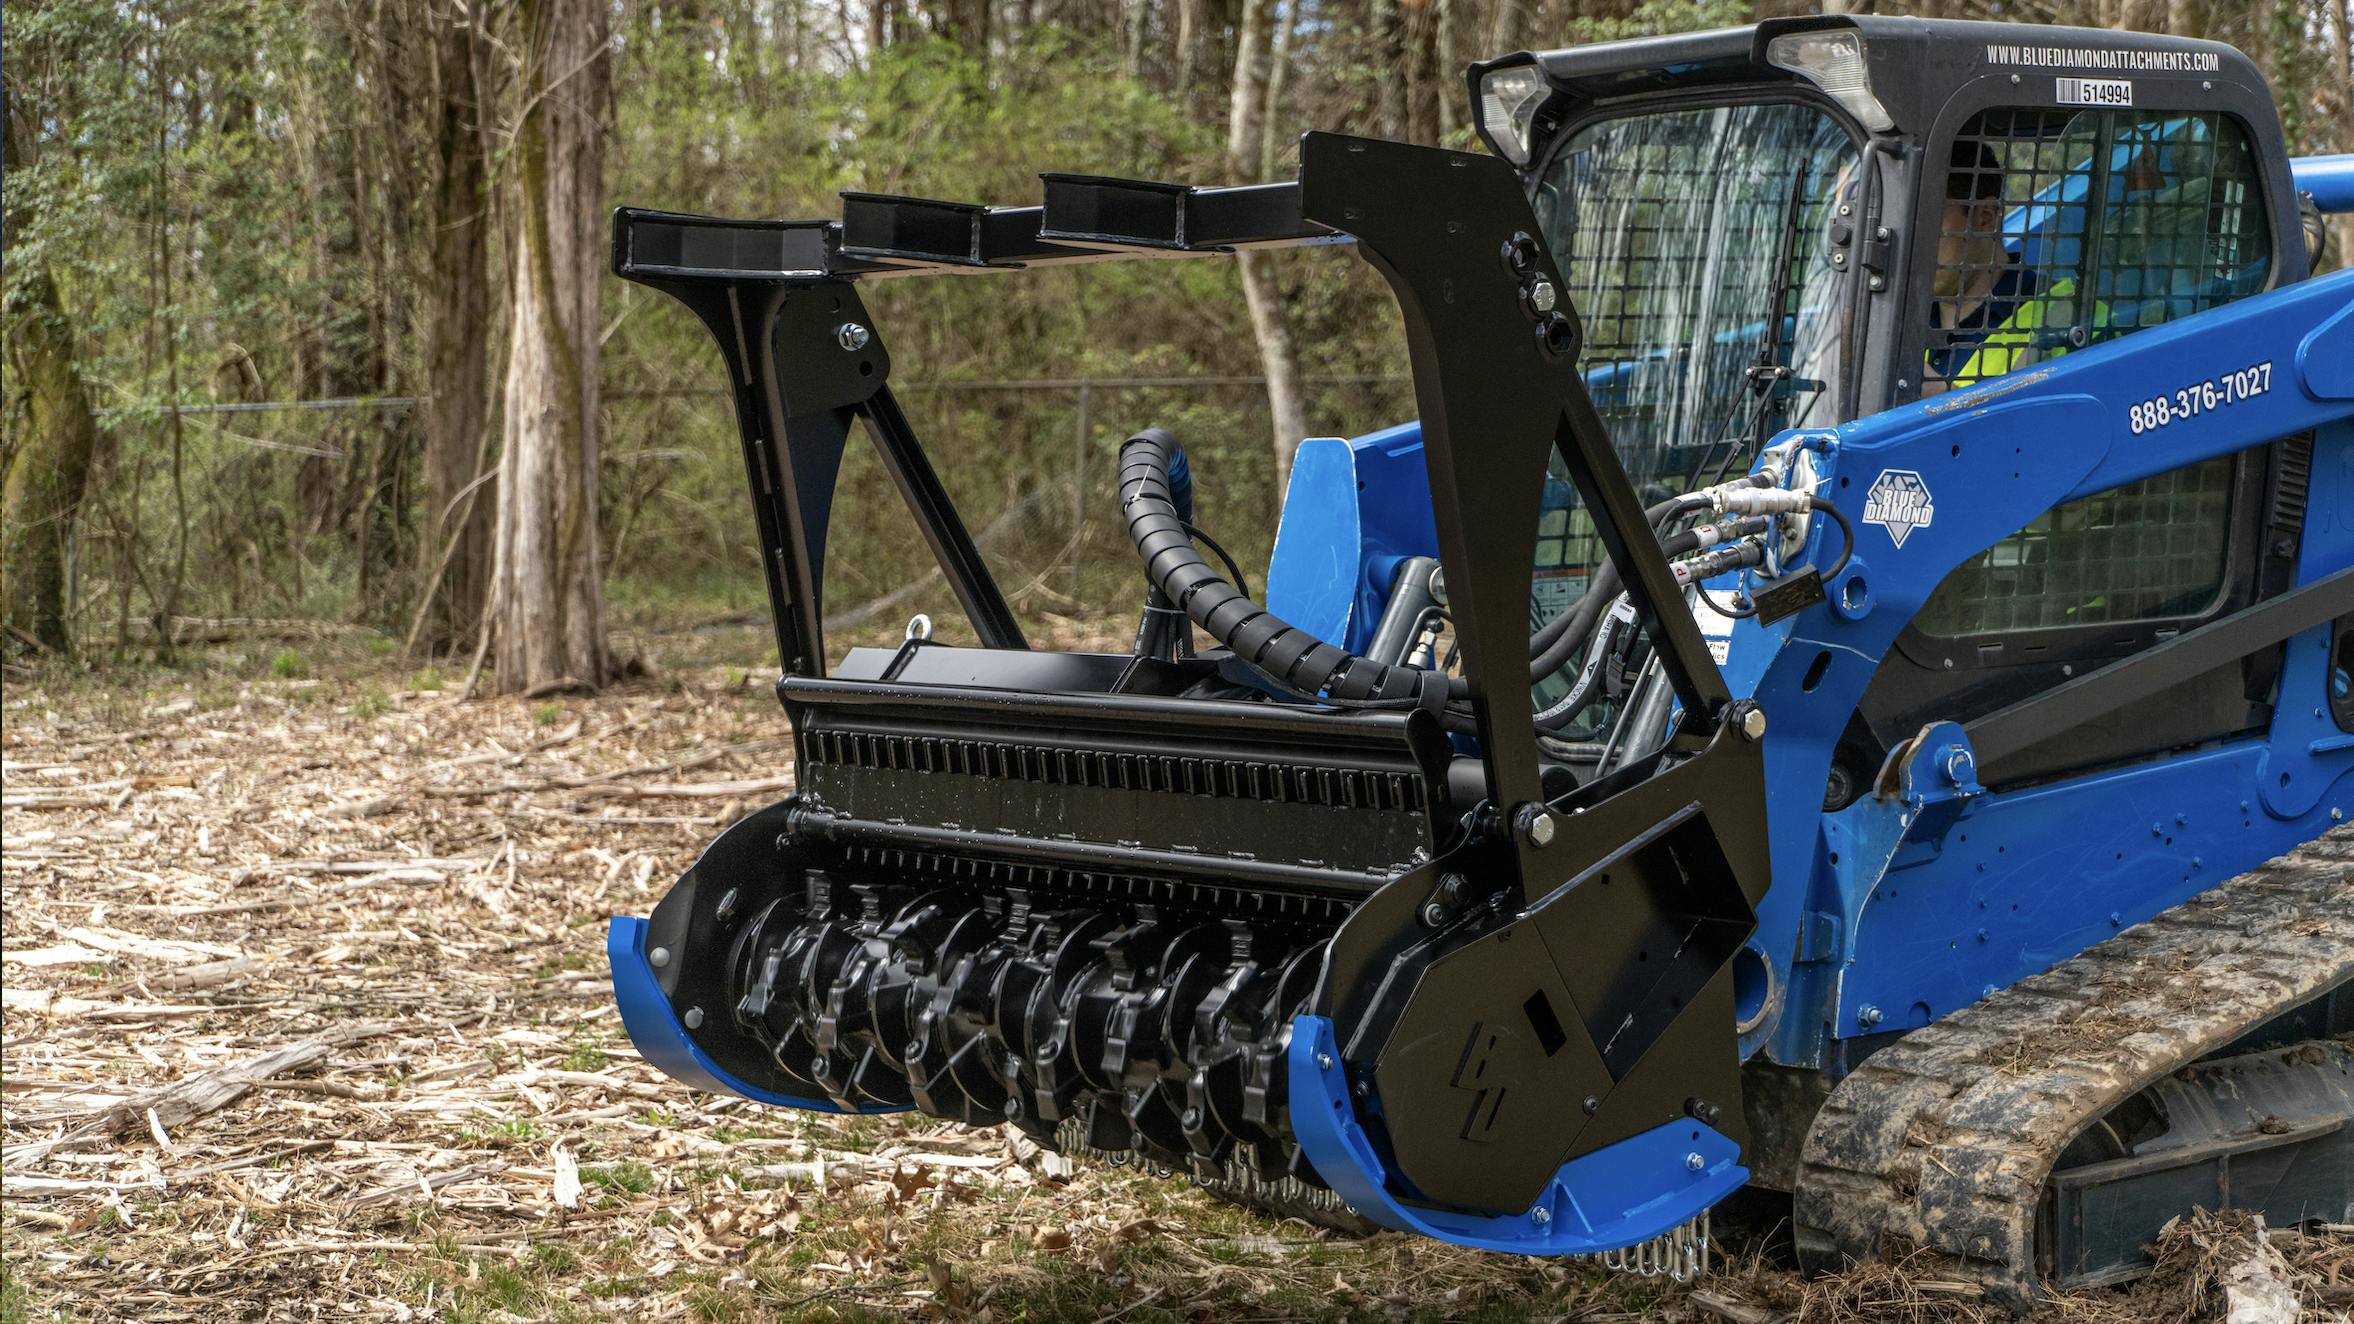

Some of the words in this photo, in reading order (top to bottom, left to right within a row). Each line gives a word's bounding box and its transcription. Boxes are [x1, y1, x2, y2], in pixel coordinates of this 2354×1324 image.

[1987, 45, 2219, 71] WWW.BLUEDIAMONDATTACHMENTS.COM
[2083, 84, 2131, 104] 514994
[2129, 362, 2272, 434] 888-376-7027
[1882, 489, 1917, 507] BLUE
[1865, 503, 1931, 523] DIAMOND
